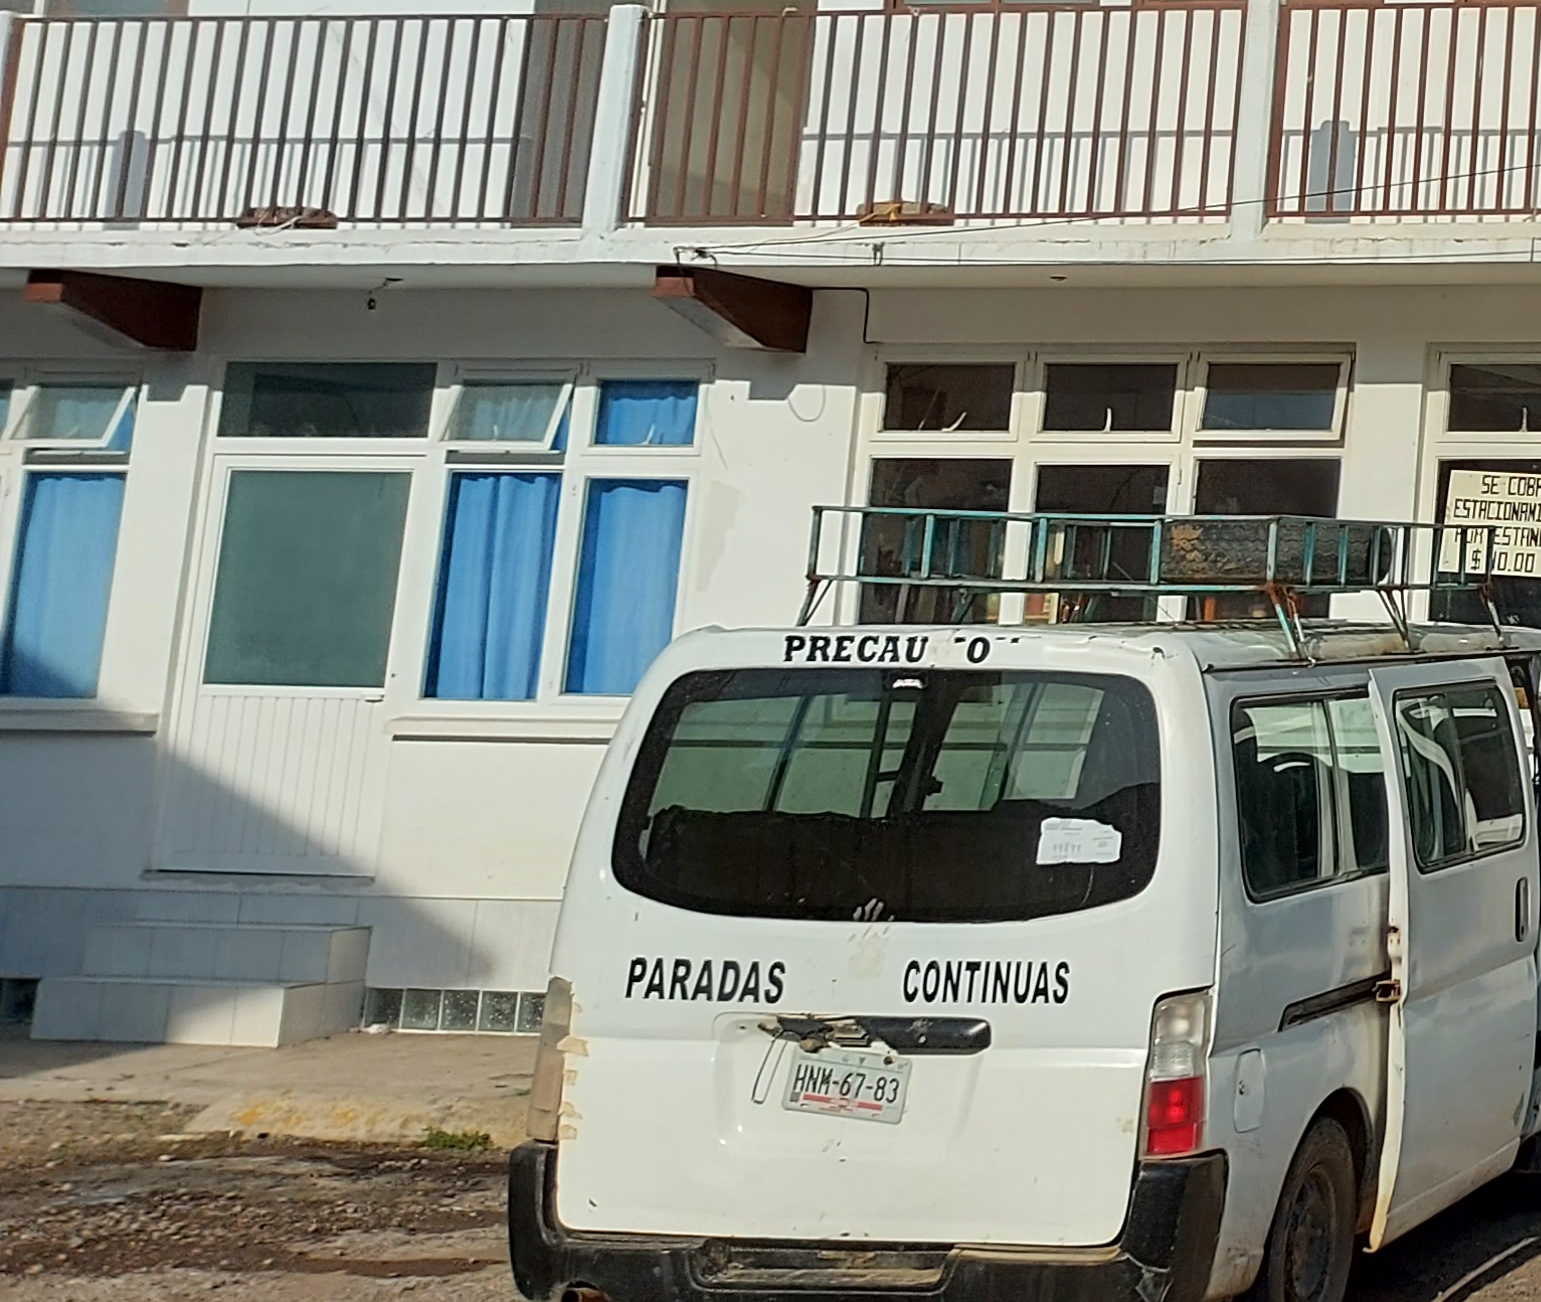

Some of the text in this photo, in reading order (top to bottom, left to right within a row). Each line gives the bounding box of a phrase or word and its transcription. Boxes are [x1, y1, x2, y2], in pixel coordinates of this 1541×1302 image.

[1481, 475, 1501, 495] SE
[625, 956, 1071, 1005] PARADAS CONTINUAS
[792, 1063, 900, 1104] HNM-67-83
